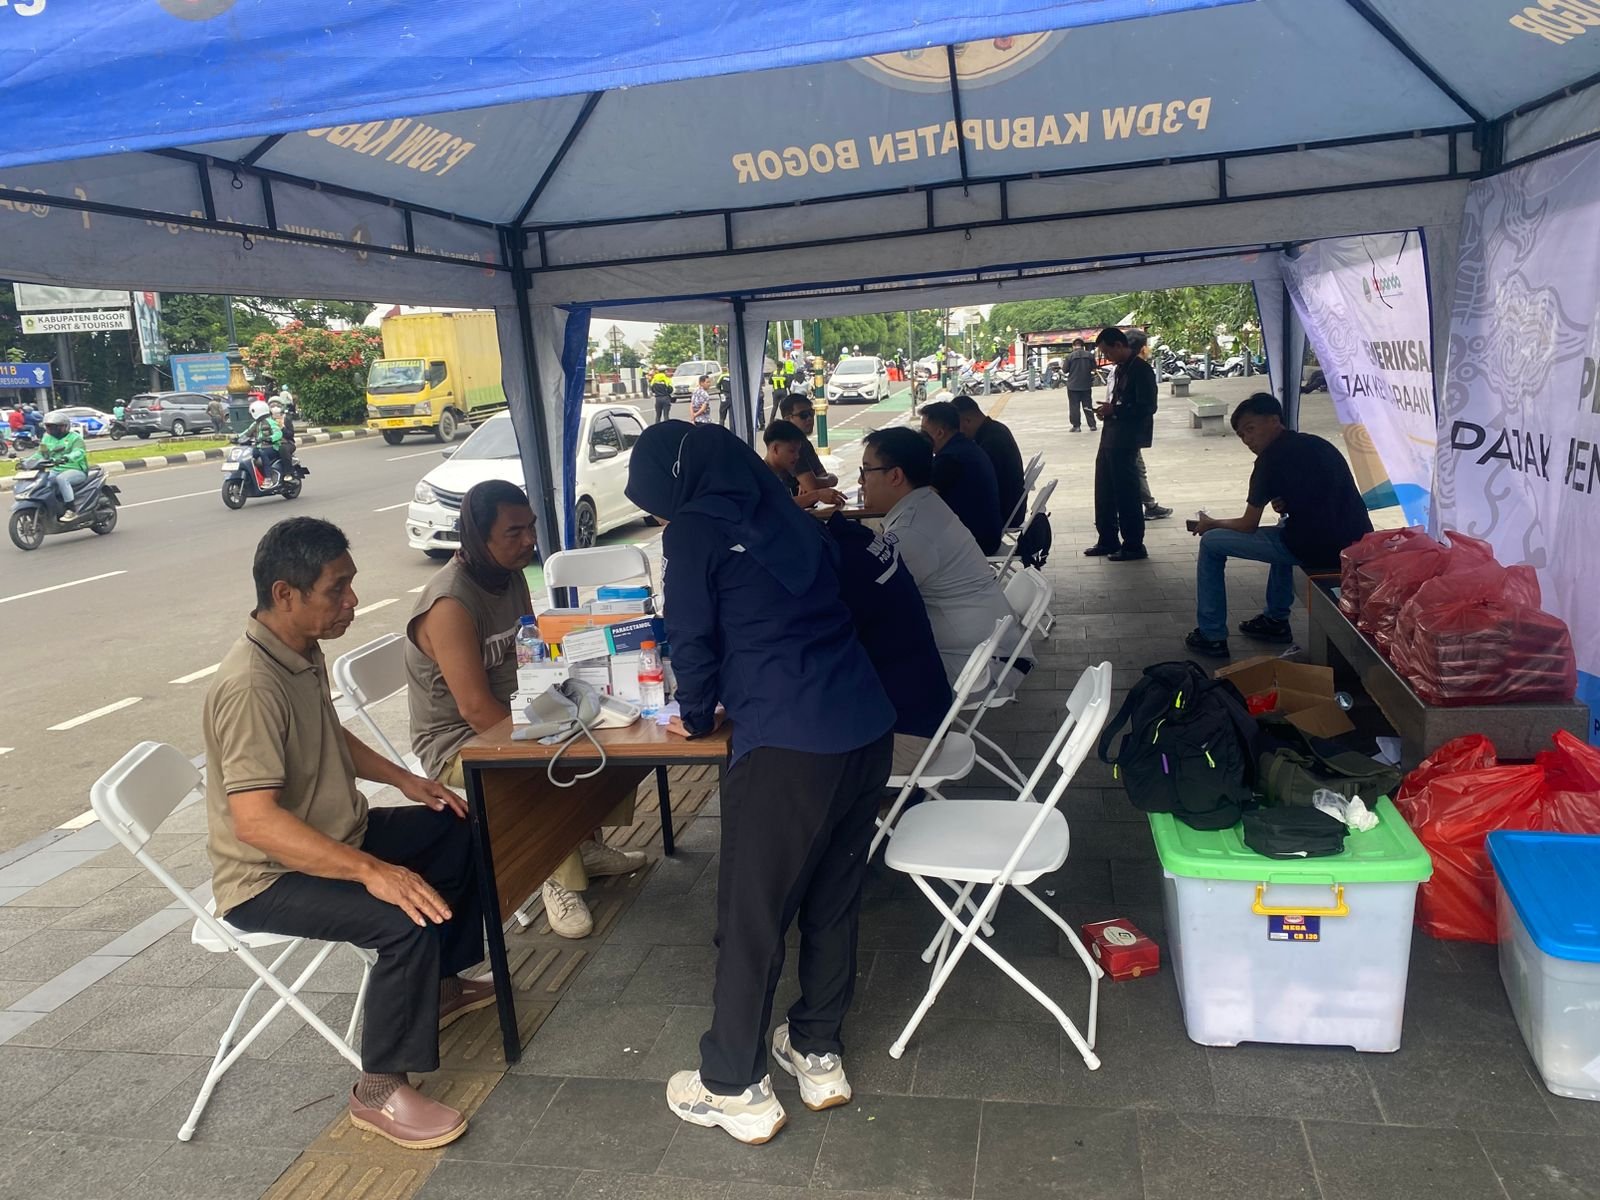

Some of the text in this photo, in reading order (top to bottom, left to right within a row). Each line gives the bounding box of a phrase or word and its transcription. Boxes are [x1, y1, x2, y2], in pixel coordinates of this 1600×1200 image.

[38, 313, 126, 324] KABUPATEN BOGOR
[43, 322, 72, 331] SPORT
[82, 321, 124, 330] TOURISM
[612, 622, 652, 635] PARACETAMOL
